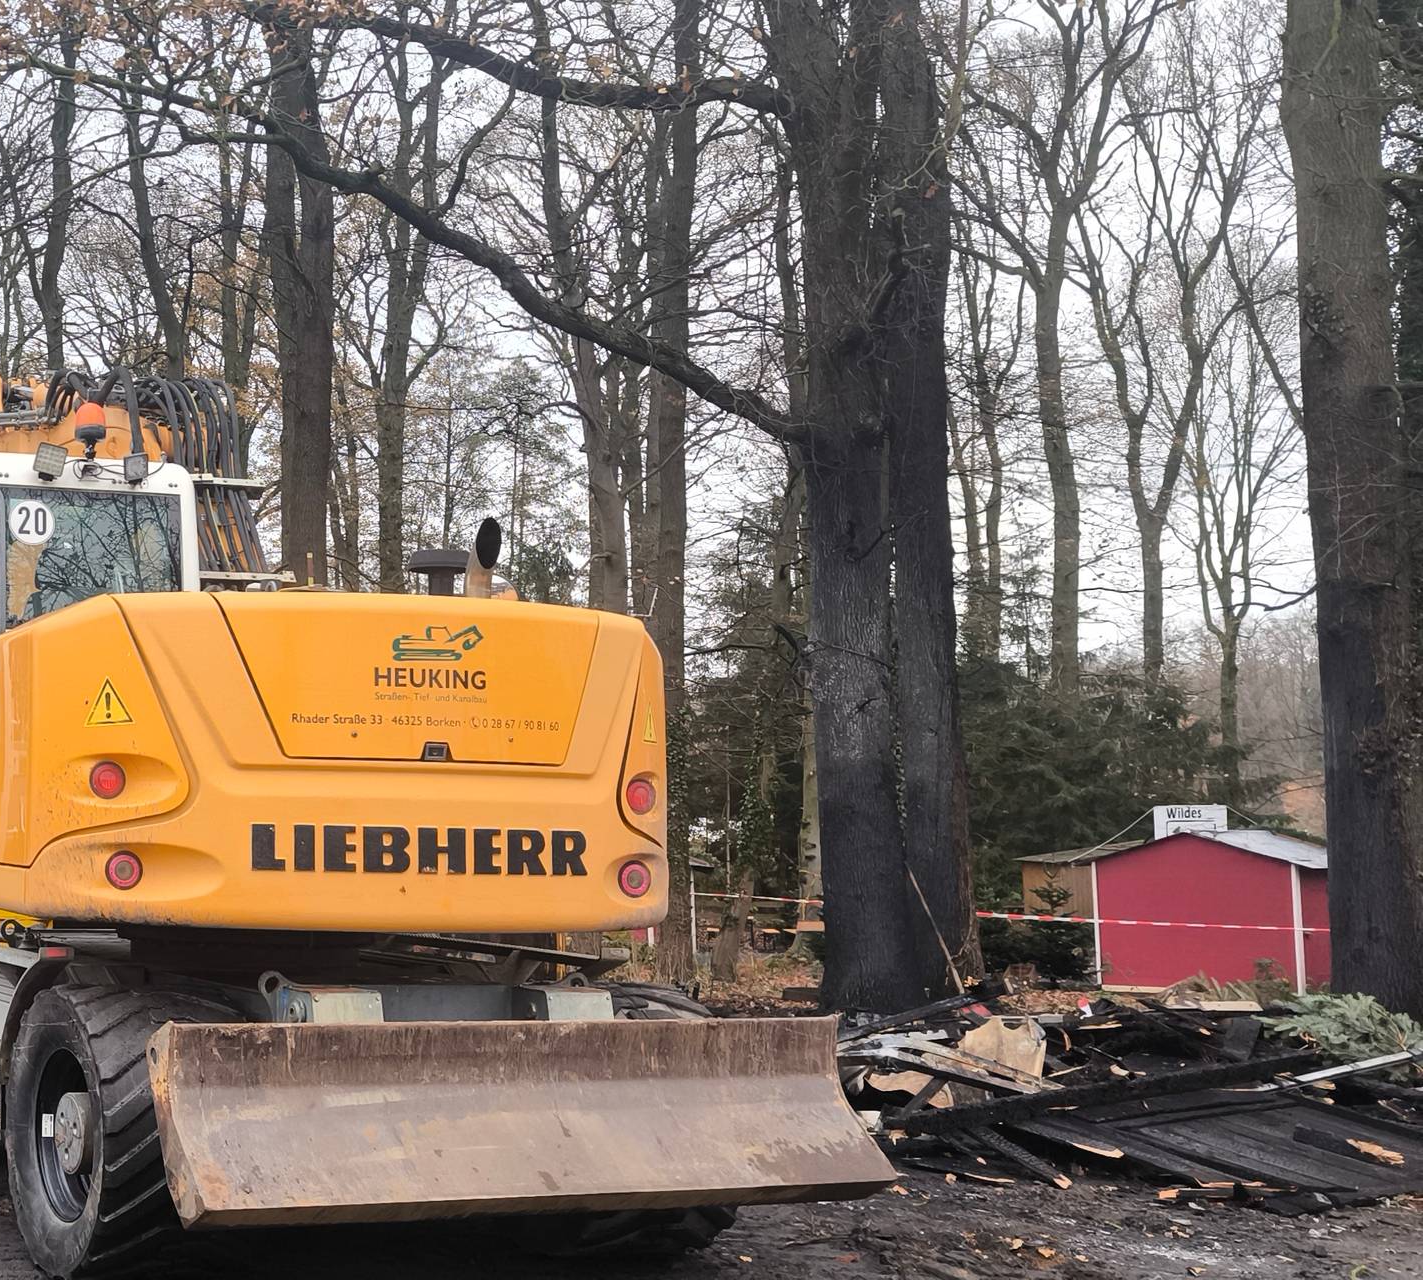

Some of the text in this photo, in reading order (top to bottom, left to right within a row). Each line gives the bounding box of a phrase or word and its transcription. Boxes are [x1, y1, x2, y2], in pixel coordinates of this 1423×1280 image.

[18, 506, 47, 535] 20
[374, 667, 487, 690] HEUKING
[375, 692, 410, 701] Straßen-
[291, 713, 329, 724] Rhader
[333, 714, 367, 725] Straße
[370, 715, 383, 725] 33
[391, 716, 423, 726] 46325
[426, 717, 461, 728] Borken
[482, 718, 488, 729] 0
[491, 719, 502, 729] 28
[505, 720, 515, 729] 67
[524, 720, 534, 730] 90
[537, 720, 546, 730] 81
[549, 721, 559, 731] 60
[1166, 808, 1202, 819] Wildes
[251, 824, 588, 876] LIEBHERR
